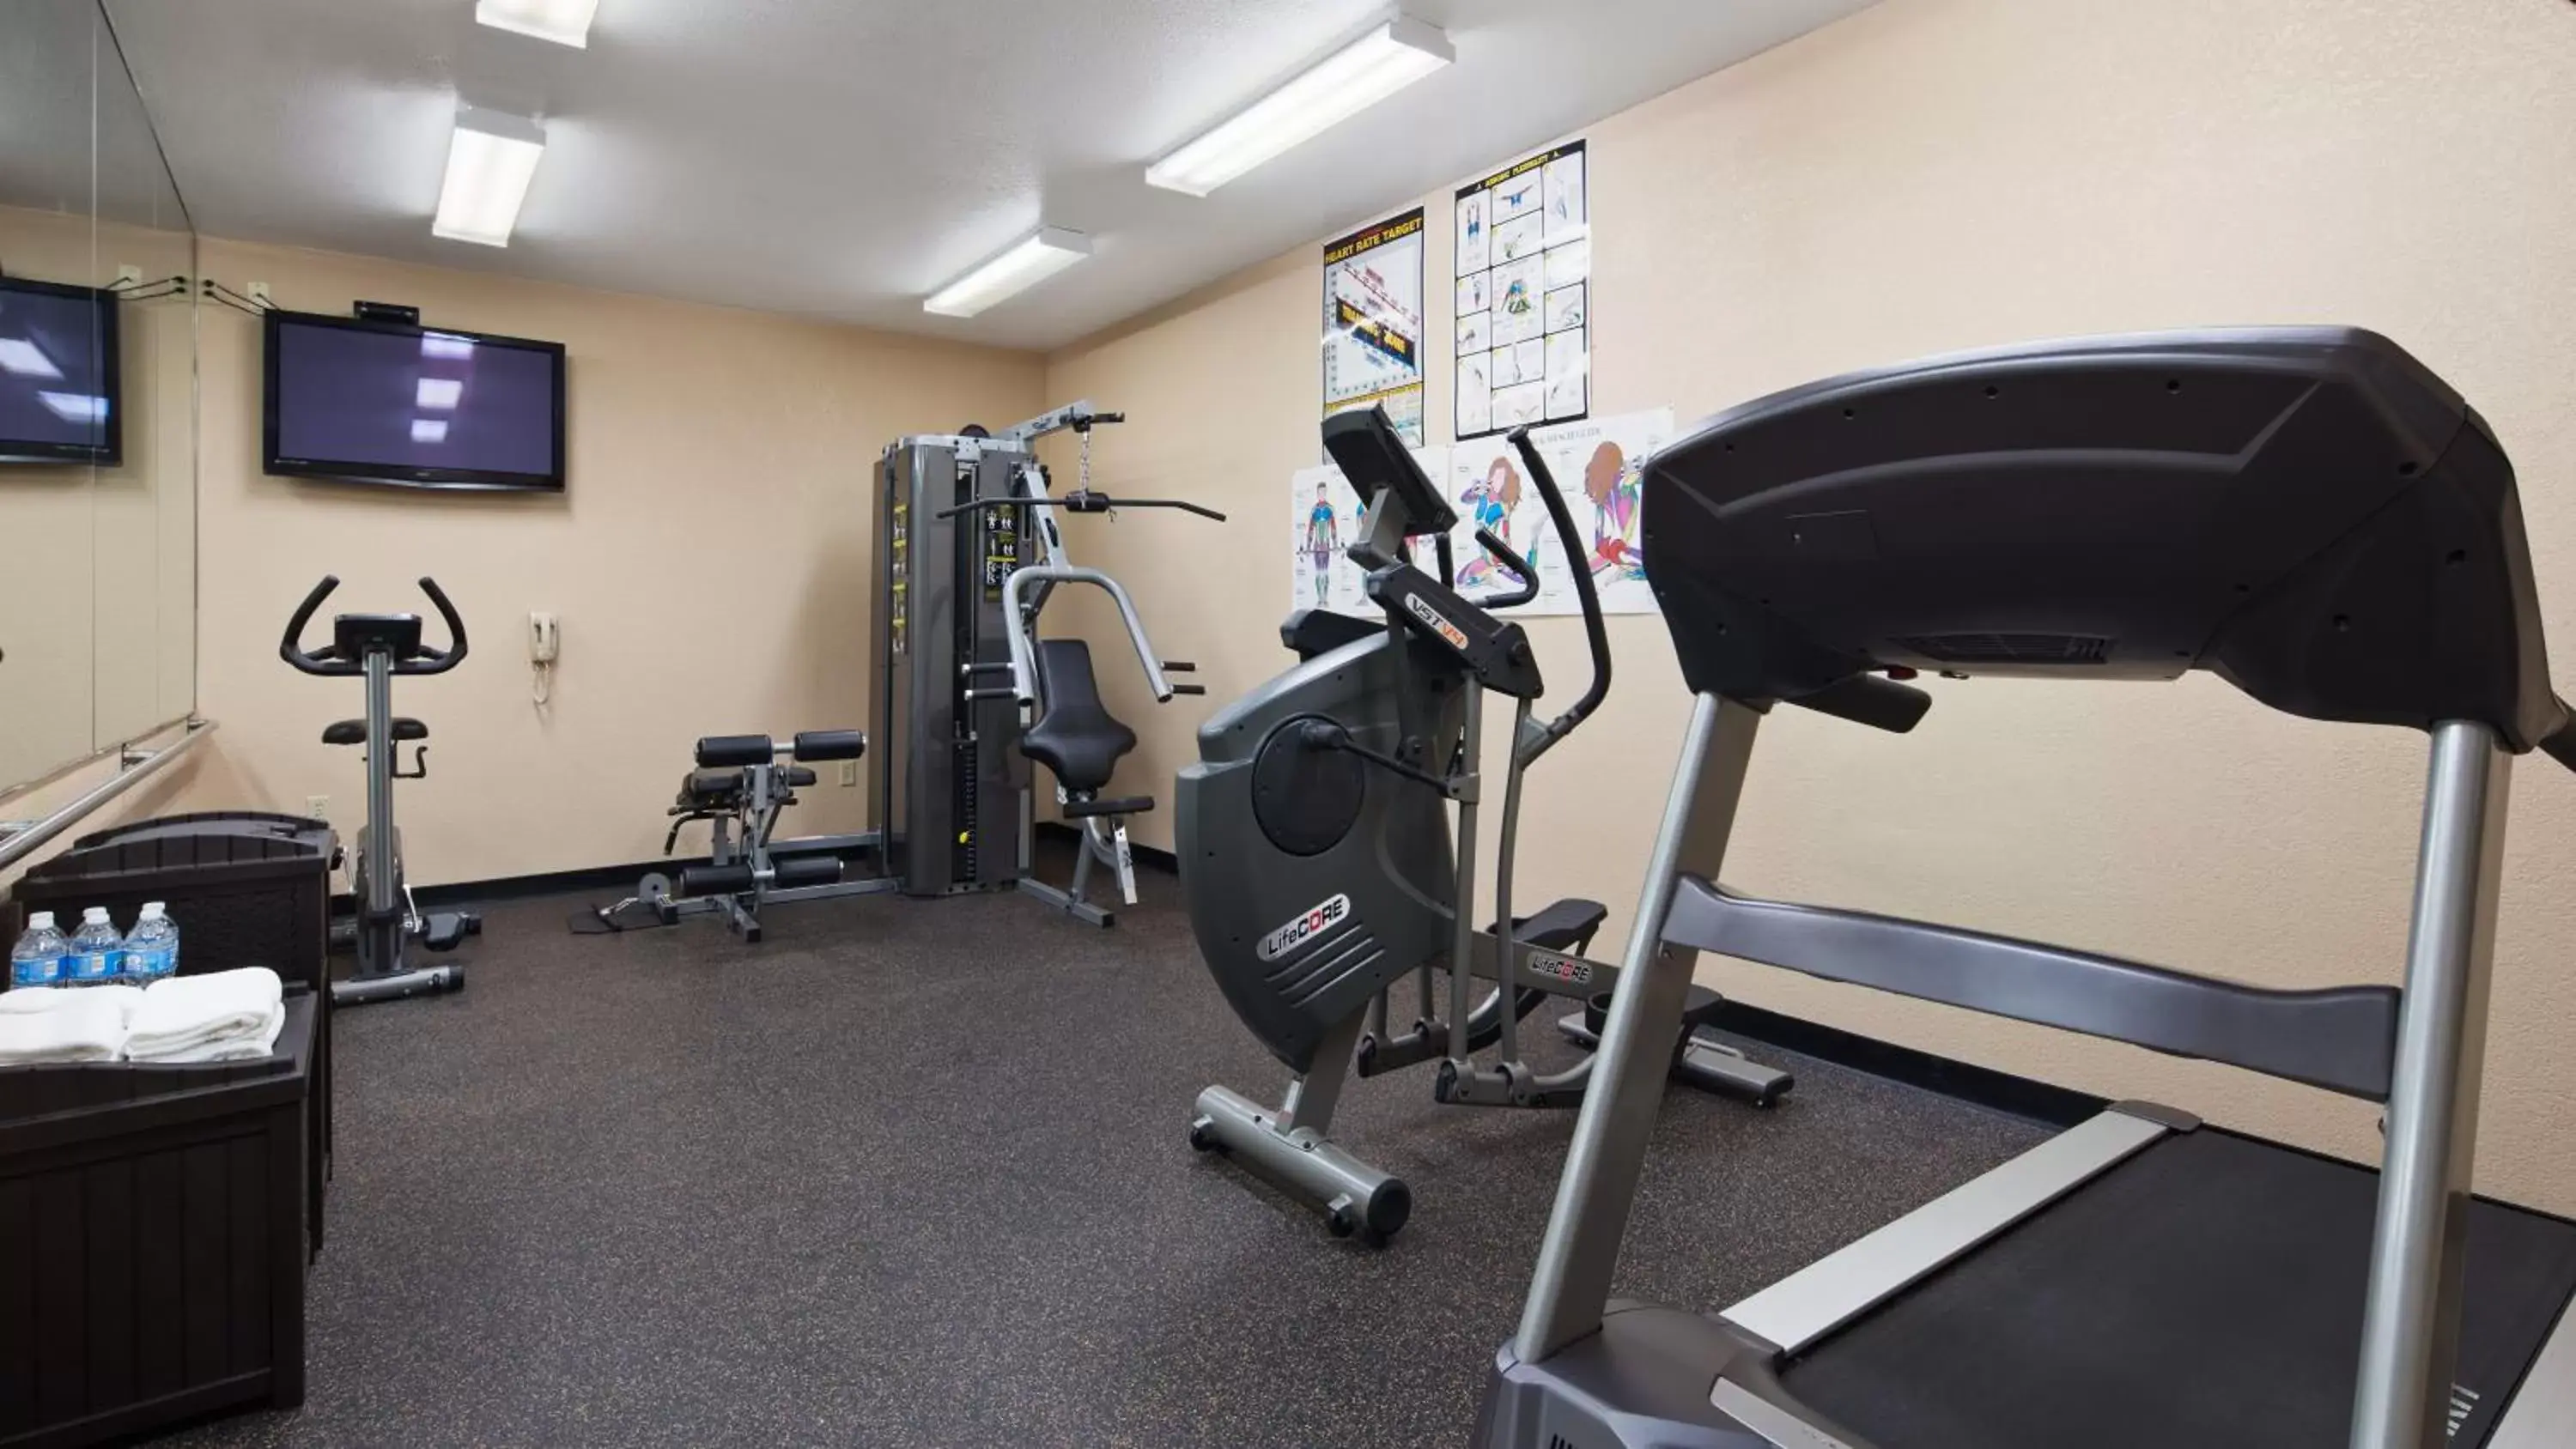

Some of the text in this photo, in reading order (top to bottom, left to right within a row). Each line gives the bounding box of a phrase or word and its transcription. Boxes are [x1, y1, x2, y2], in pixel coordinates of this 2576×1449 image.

[1325, 244, 1354, 264] HEART
[1356, 232, 1381, 252] RATE
[1382, 217, 1423, 241] TARGET
[1268, 896, 1344, 955] LifeCORE
